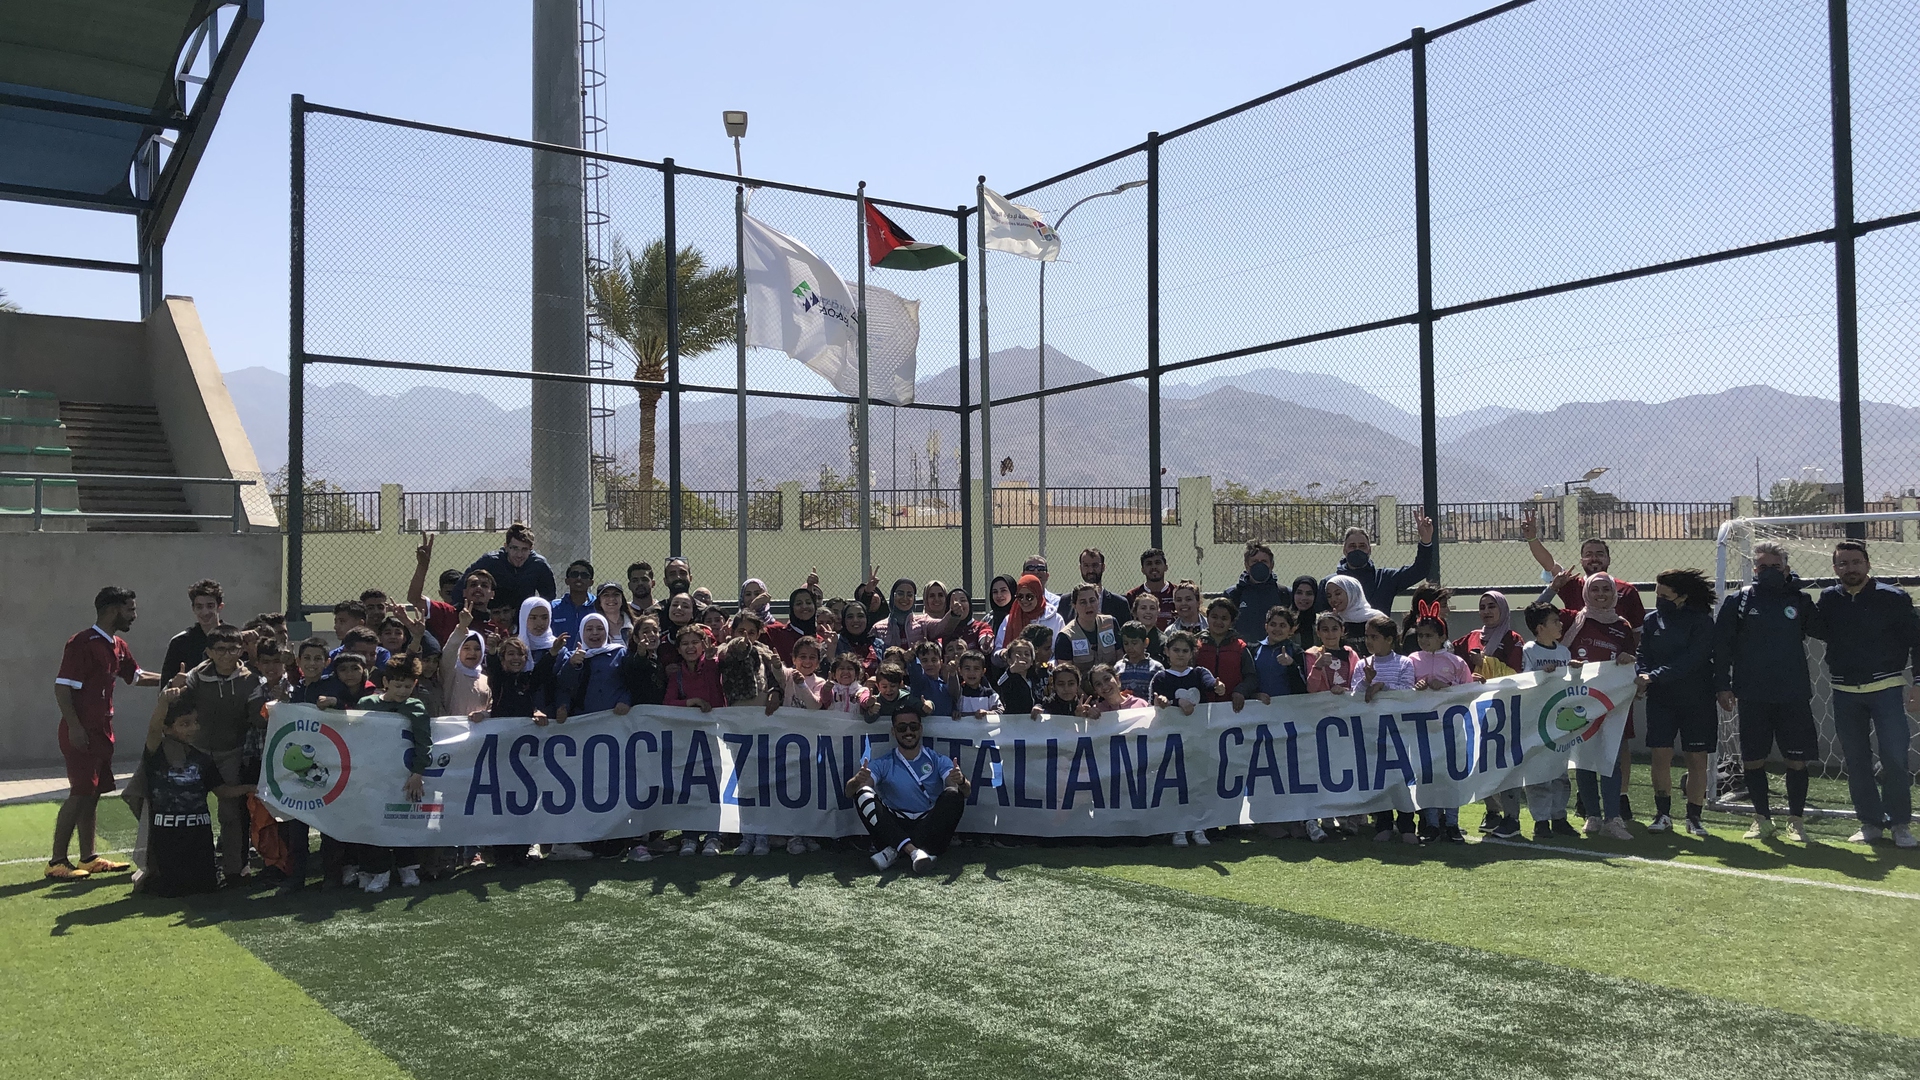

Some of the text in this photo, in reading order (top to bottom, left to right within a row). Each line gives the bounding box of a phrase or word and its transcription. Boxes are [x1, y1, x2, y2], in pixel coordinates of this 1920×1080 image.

[1567, 685, 1588, 697] AIC
[297, 719, 320, 733] AIC
[1556, 735, 1584, 753] JUNIOR
[922, 733, 1189, 810] TALIANA
[1216, 694, 1524, 799] CALCIATORI
[280, 796, 325, 811] JUNIOR
